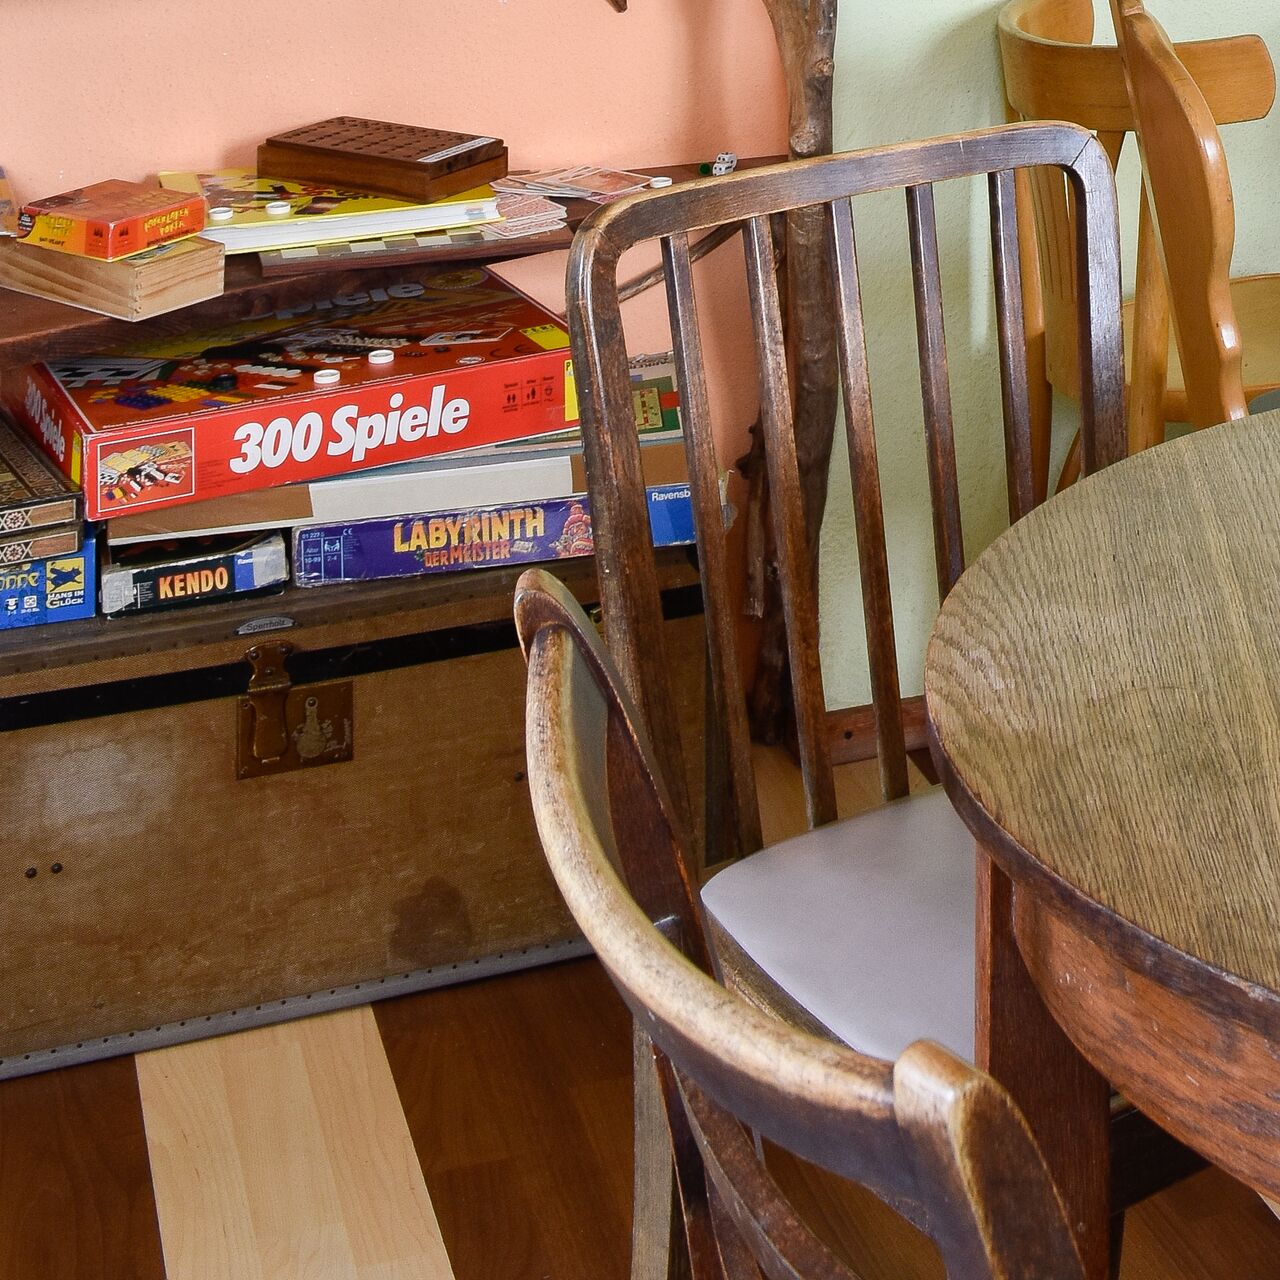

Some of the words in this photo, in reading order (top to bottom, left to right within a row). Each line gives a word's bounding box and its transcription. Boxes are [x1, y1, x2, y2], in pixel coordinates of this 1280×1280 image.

[229, 412, 323, 474] 300
[328, 384, 471, 463] Spiele
[393, 506, 545, 553] LABYRINTH
[424, 549, 448, 568] DER
[450, 540, 511, 565] MEISTER
[159, 567, 229, 600] KENDO
[46, 598, 84, 608] GLÜCK
